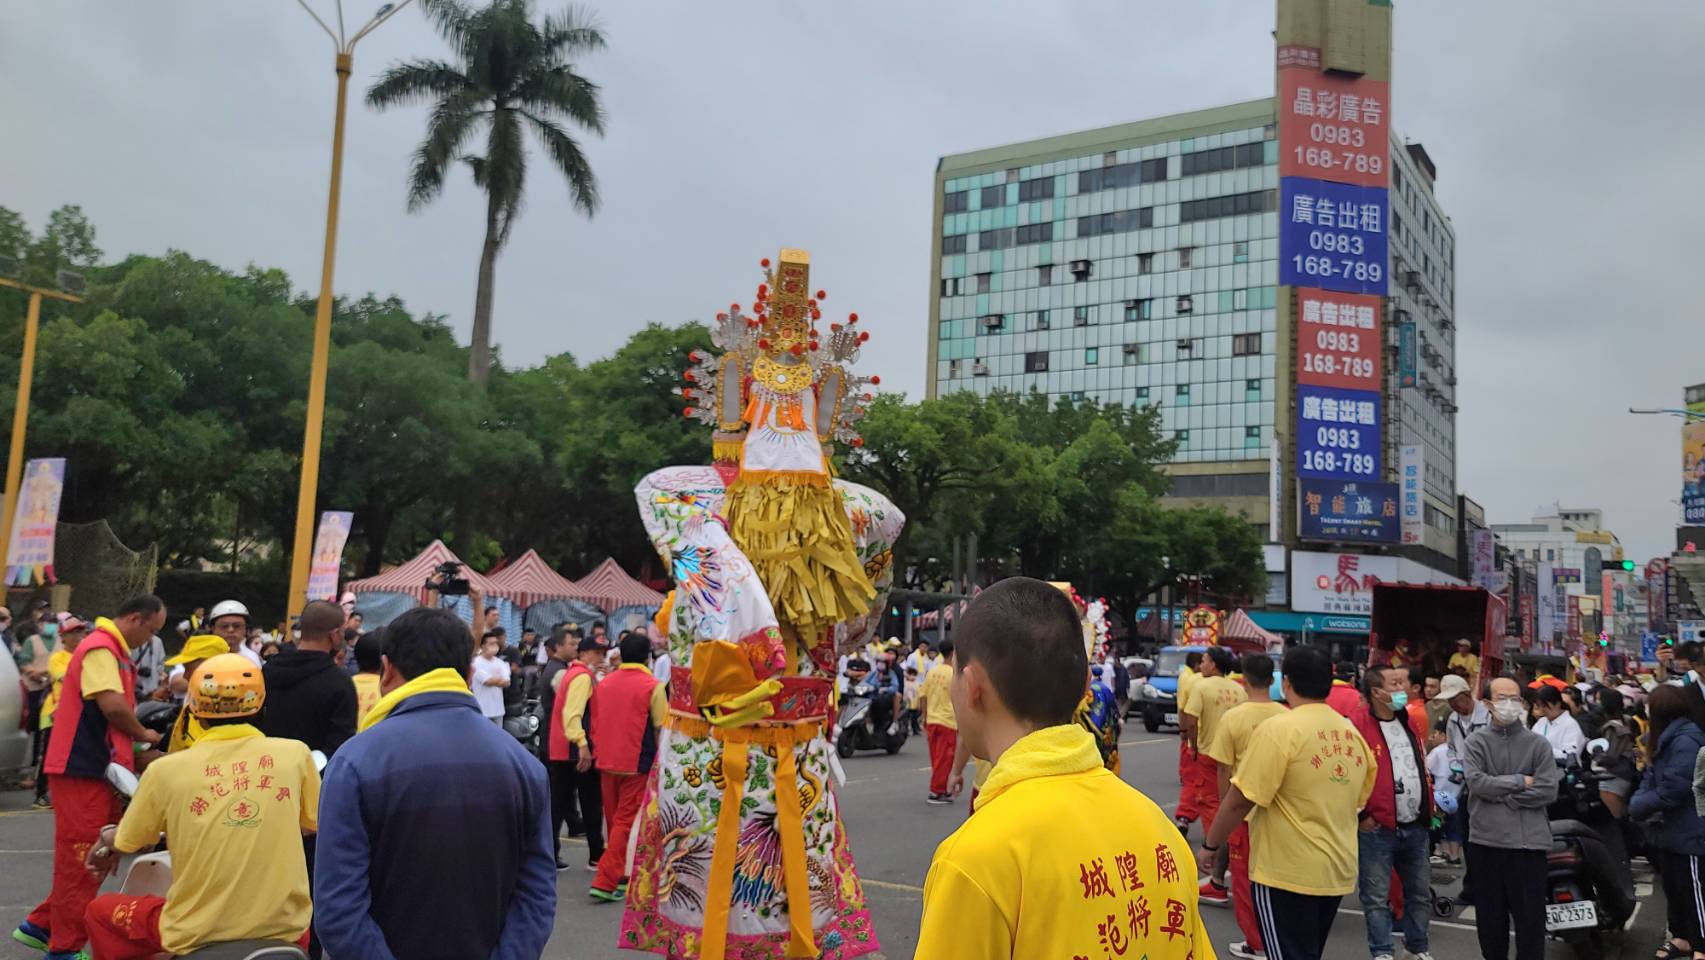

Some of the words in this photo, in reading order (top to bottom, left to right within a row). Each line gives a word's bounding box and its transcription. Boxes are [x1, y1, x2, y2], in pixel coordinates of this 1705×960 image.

[1293, 87, 1382, 125] 晶彩廣告
[1310, 123, 1365, 148] 0983
[1294, 146, 1383, 174] 168-789
[1292, 195, 1381, 233] 廣告出租
[1309, 231, 1364, 255] 0983
[1292, 254, 1382, 282] 168-789
[1303, 300, 1375, 329] 廣告出租
[1316, 330, 1360, 352] 0983
[1303, 353, 1374, 378] 168-789
[1303, 396, 1375, 425] 廣告出租
[1317, 427, 1360, 449] 0983
[1303, 450, 1374, 475] 168-789
[1305, 491, 1396, 517] 智能旅店
[1329, 618, 1367, 629] watsons
[204, 754, 274, 777] 城隍廟
[1079, 843, 1180, 900] 城隍廟
[1092, 895, 1194, 960] 范將軍
